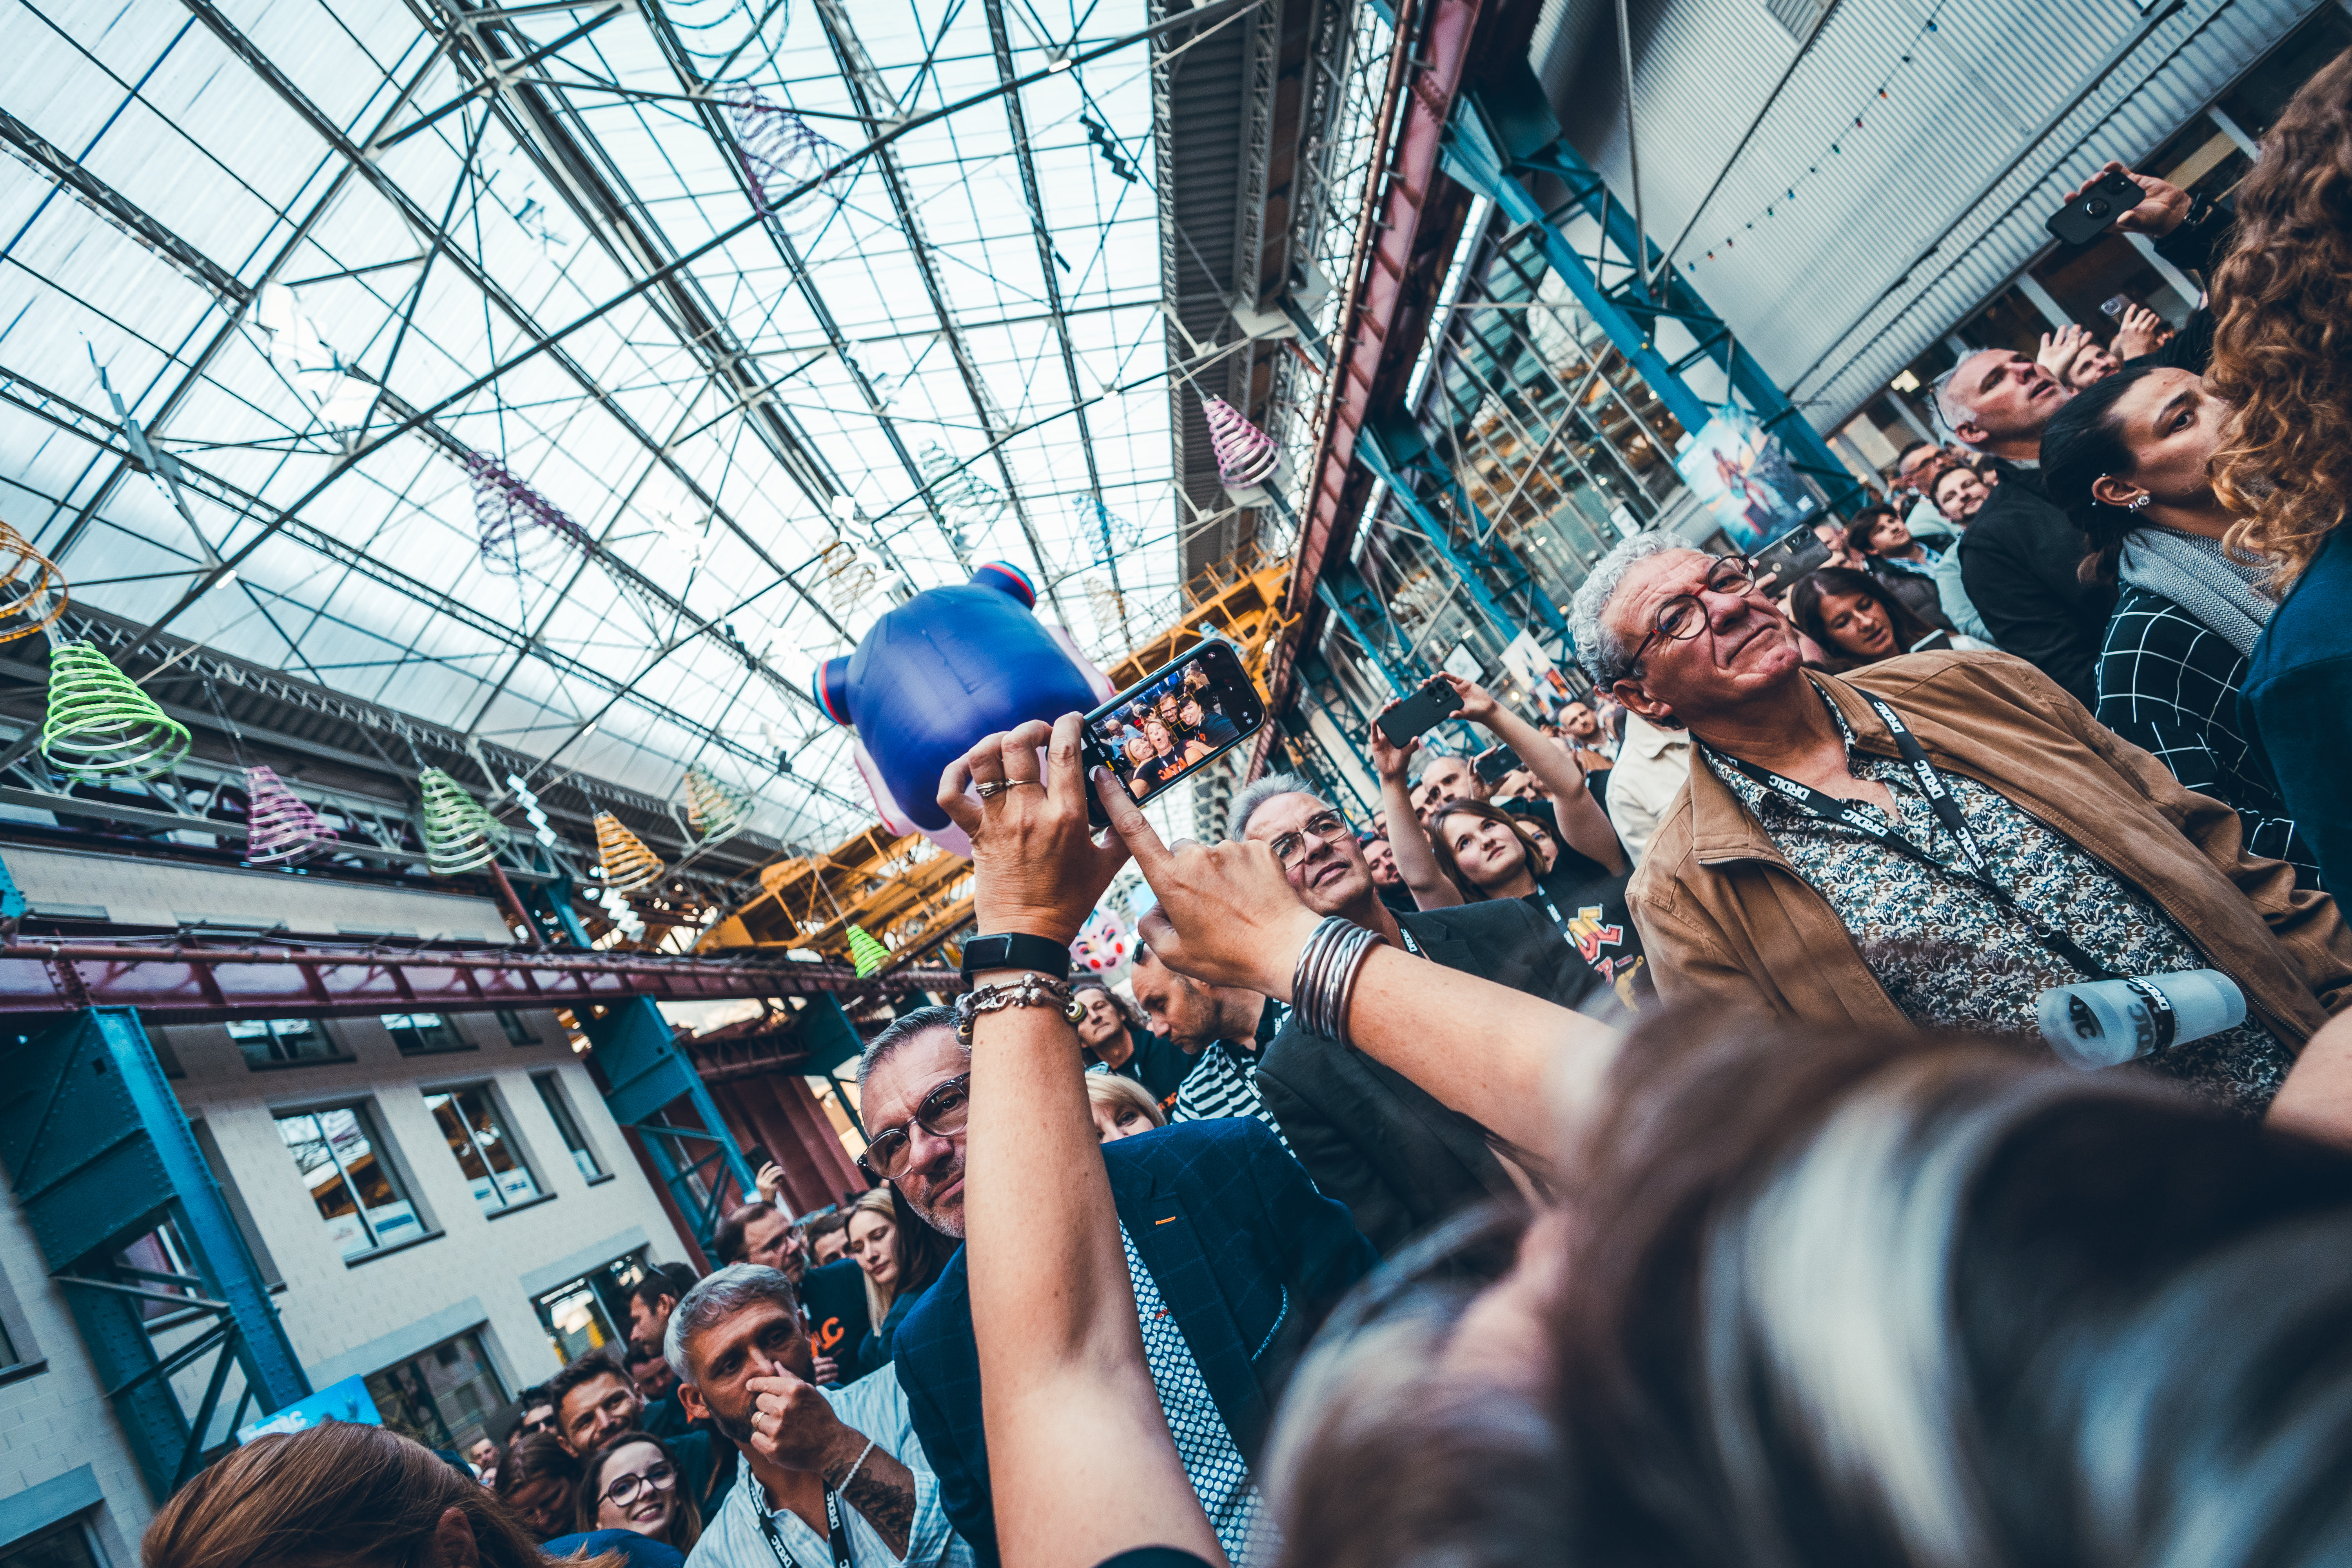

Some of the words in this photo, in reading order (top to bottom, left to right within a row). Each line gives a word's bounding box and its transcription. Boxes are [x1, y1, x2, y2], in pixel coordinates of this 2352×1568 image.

[1874, 702, 1905, 733] DRDLC
[1106, 760, 1114, 771] PHOTO
[1914, 760, 1945, 800] DRDLC
[1769, 775, 1810, 801] DRDLC
[1841, 809, 1889, 837] DRDLC
[1956, 827, 1985, 869] DRDLC
[1400, 928, 1418, 952] DRDLC
[2129, 977, 2171, 1010] DRDLC
[826, 1491, 840, 1530] DRDLC
[771, 1534, 793, 1568] DRDLC
